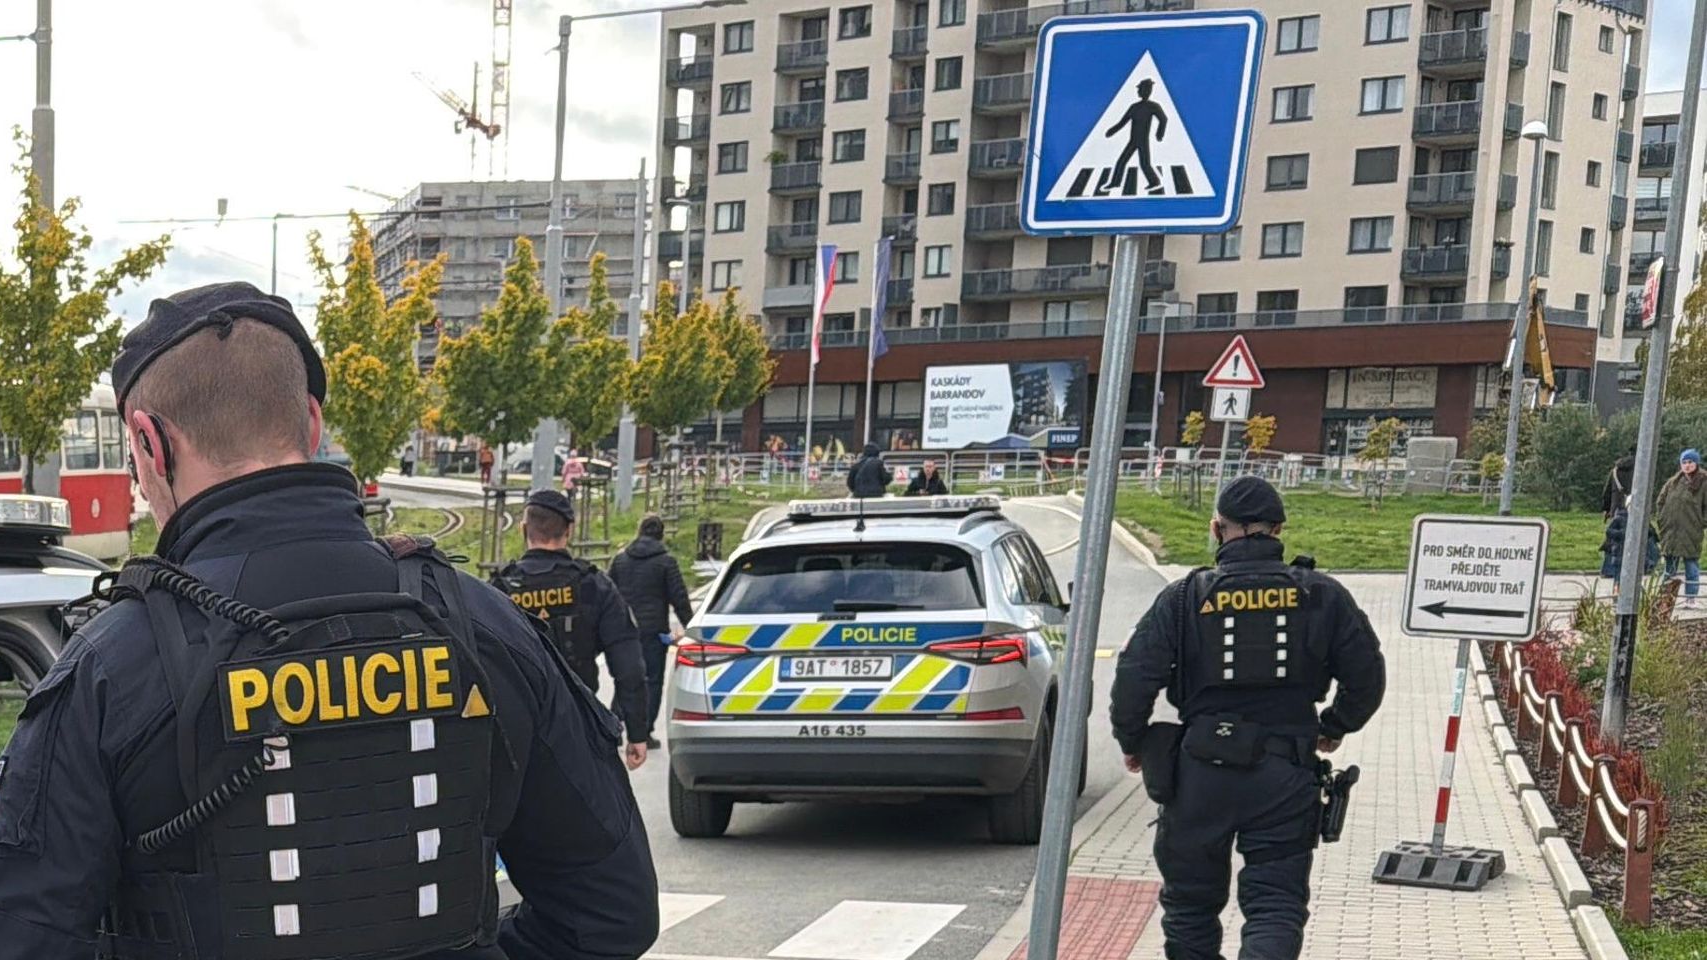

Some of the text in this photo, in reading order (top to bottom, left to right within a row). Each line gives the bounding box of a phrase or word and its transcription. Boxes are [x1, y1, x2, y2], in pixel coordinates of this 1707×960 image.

[930, 389, 985, 400] BARRANDOV
[1423, 544, 1534, 561] PRO SMĚR DO HOLYNĚ
[1450, 562, 1501, 577] PŘEJDĚTE
[1424, 579, 1497, 593] TRAMVAJOVOU
[509, 586, 574, 609] POLICIE
[1216, 587, 1299, 612] POLICIE
[841, 627, 917, 643] POLICIE
[794, 659, 827, 676] 9AT
[841, 659, 884, 675] 1857
[227, 646, 454, 732] POLICIE
[798, 725, 866, 736] A16 435
